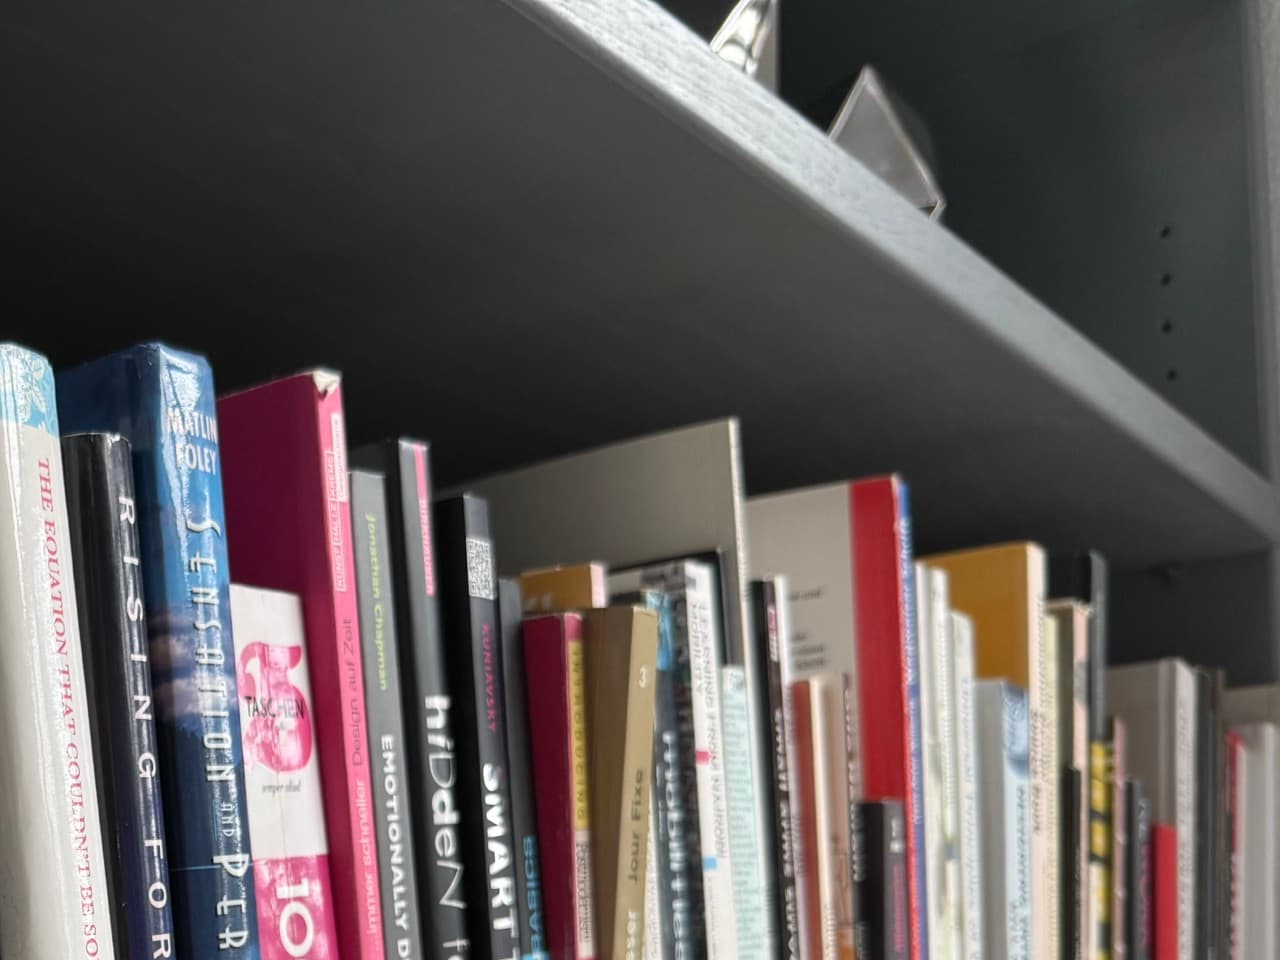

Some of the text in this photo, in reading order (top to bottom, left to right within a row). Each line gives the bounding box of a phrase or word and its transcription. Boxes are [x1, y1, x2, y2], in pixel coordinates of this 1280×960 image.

[168, 407, 217, 442] MATLIN
[175, 442, 217, 476] FOLEY
[37, 458, 53, 512] THE
[44, 520, 68, 655] EQUATION
[119, 496, 157, 780] RISING
[344, 617, 355, 655] Zeit
[373, 603, 388, 690] Chapman
[59, 666, 77, 738] THAT
[244, 695, 305, 719] TASCHEN
[347, 661, 358, 693] auf
[482, 624, 496, 733] KUNIAVSKY
[639, 664, 649, 689] 3
[347, 697, 362, 767] Design
[63, 746, 91, 874] COULDN'T
[357, 779, 372, 867] schneller
[381, 735, 409, 931] EMOTIONALLY
[627, 769, 644, 884] Jour Fixe
[482, 762, 519, 944] SMART
[80, 886, 96, 915] BE
